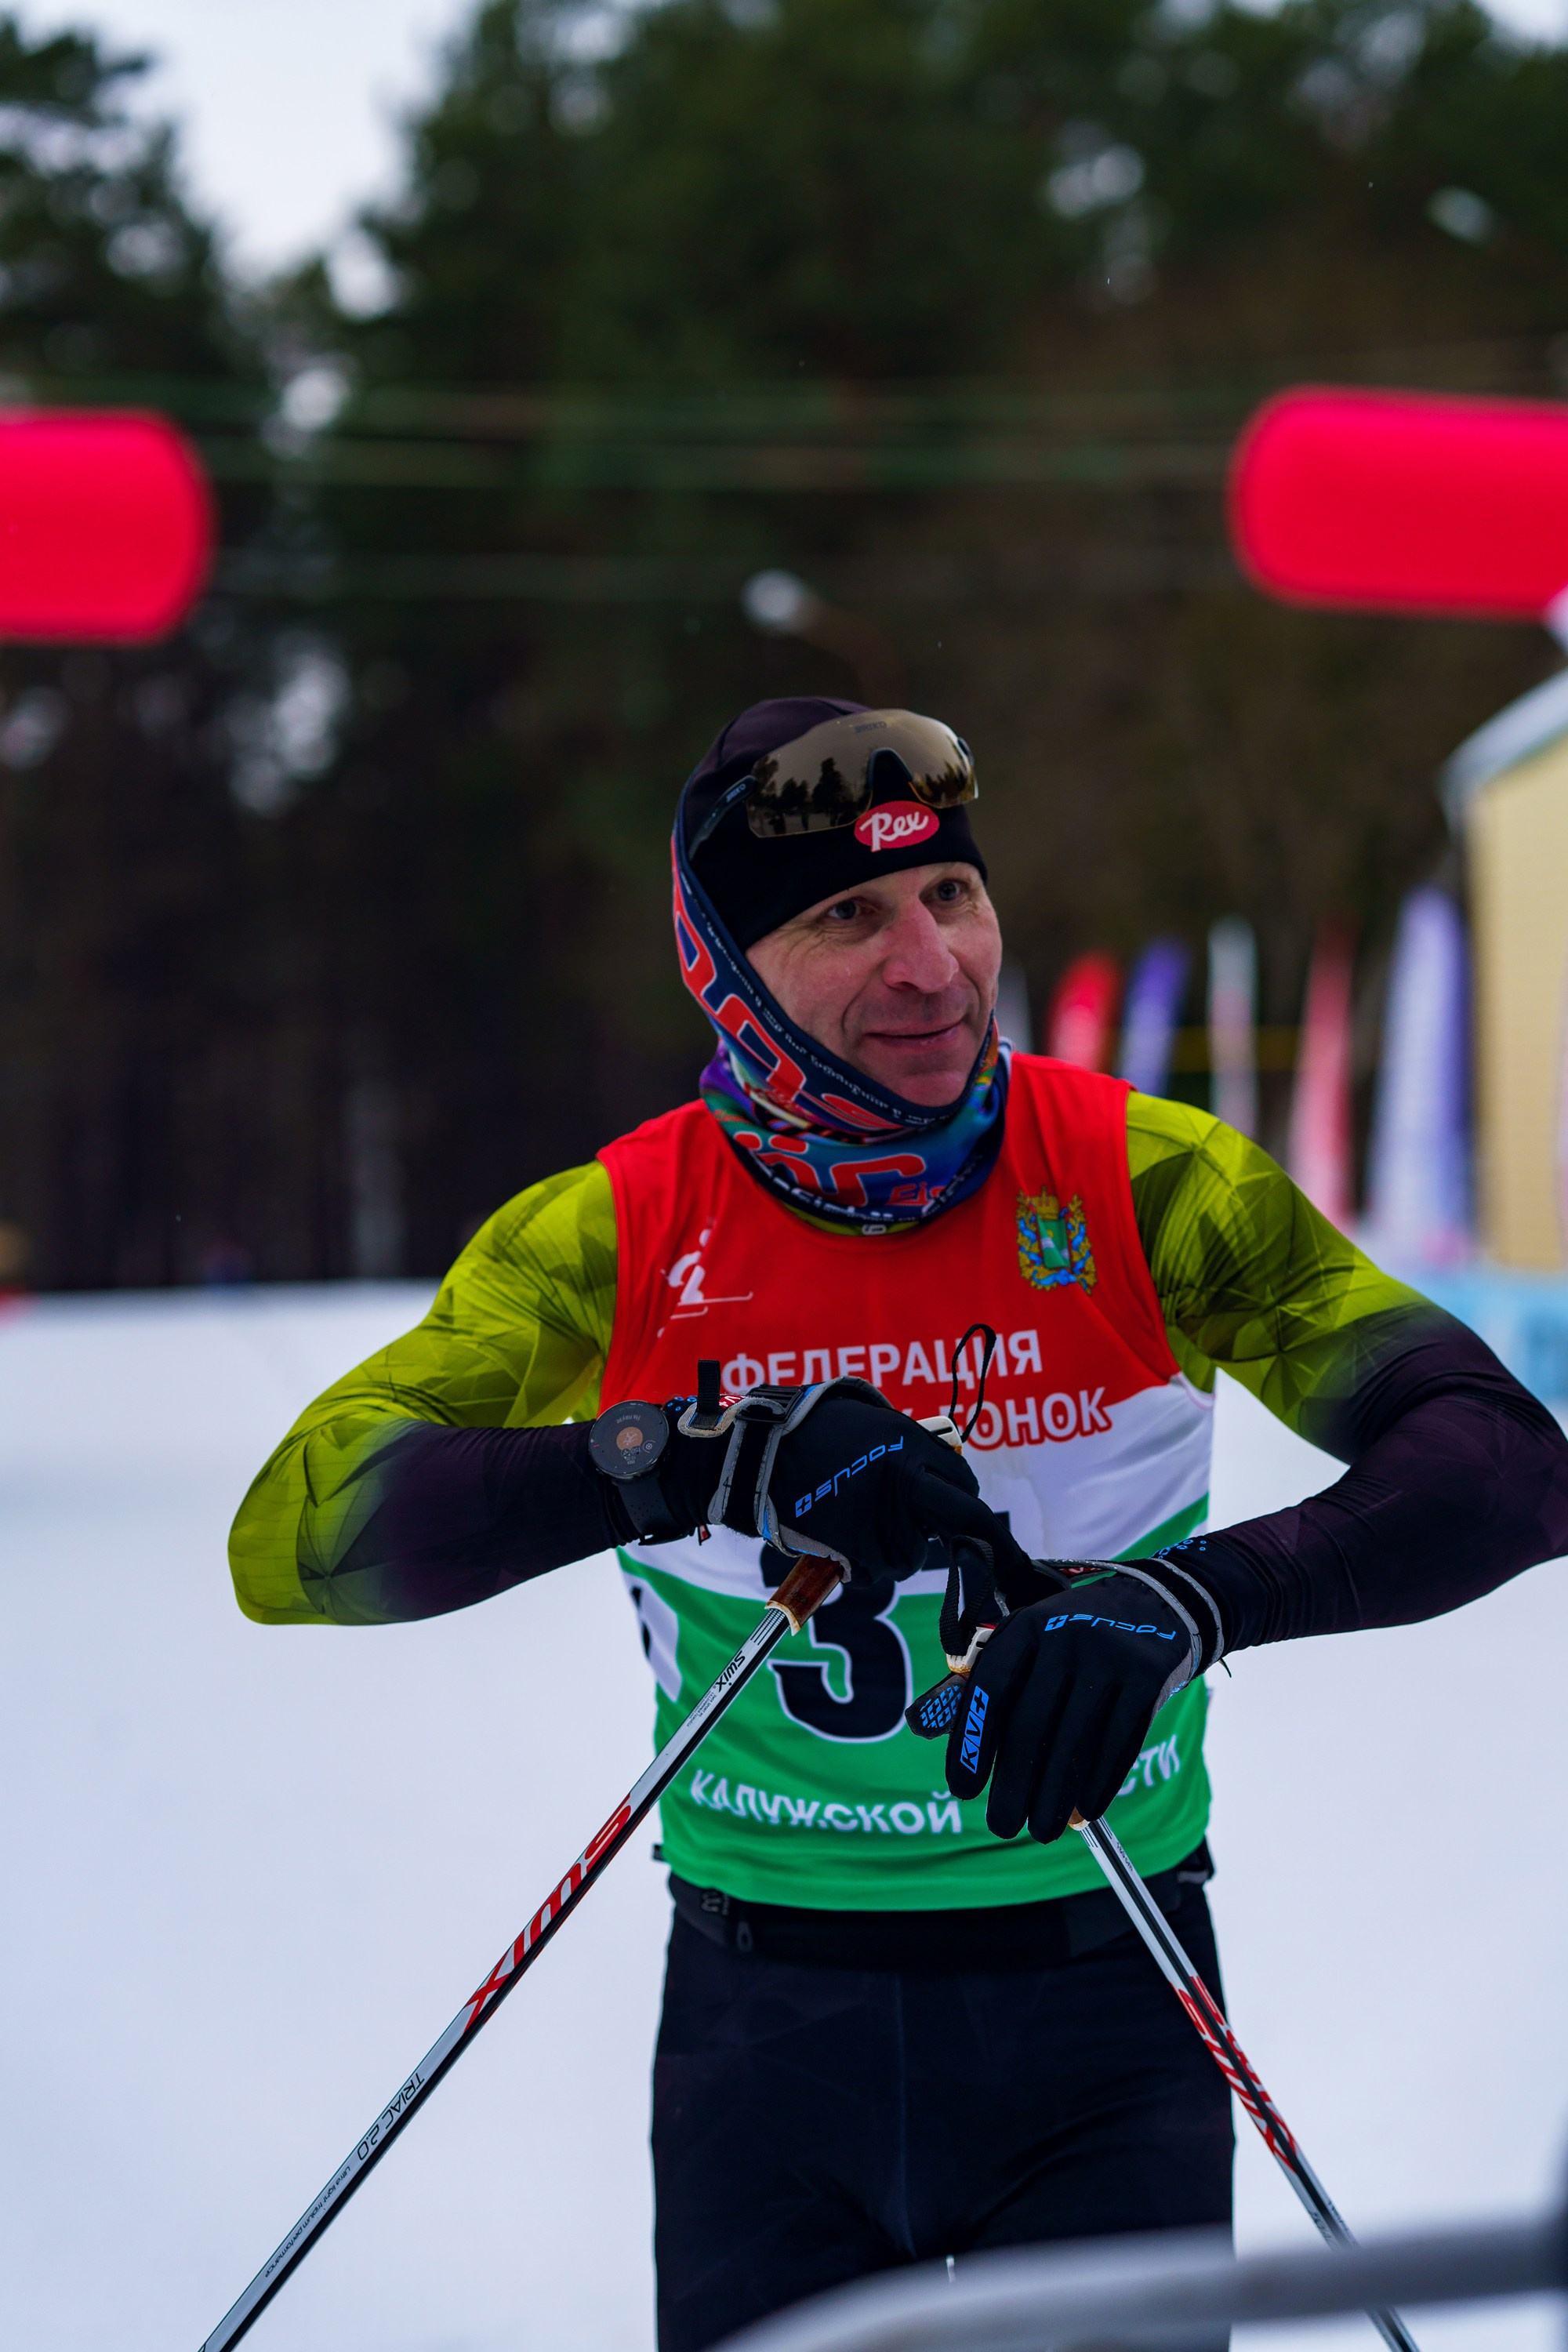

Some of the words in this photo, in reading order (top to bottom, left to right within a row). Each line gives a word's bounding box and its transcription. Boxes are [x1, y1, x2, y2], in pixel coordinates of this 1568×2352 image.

[859, 811, 928, 852] Rex
[722, 1330, 1043, 1395] ФЕДЕРАЦИЯ
[689, 1769, 962, 1835] КАЛУЖСКОЙ
[382, 2072, 425, 2130] TRIAC
[357, 2123, 380, 2161] 2.0
